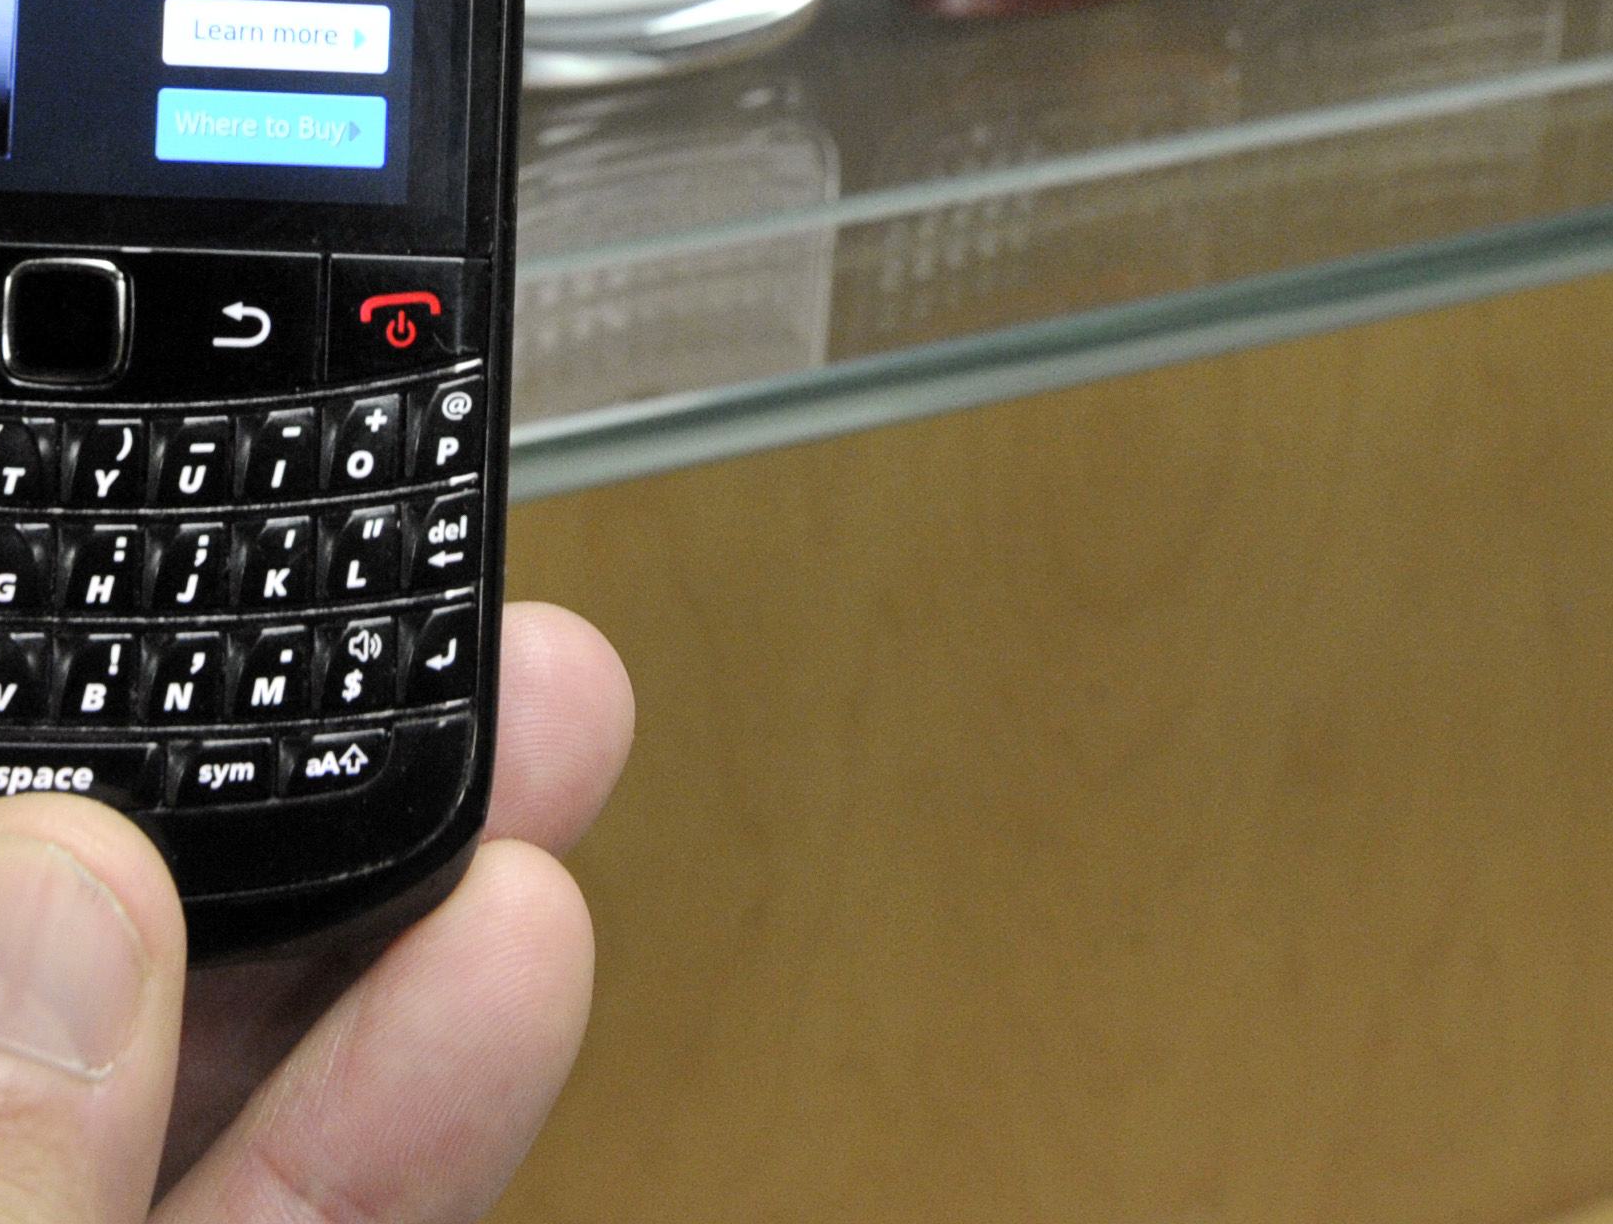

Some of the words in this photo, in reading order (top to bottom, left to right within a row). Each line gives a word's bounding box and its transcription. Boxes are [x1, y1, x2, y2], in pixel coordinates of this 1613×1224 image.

[193, 19, 264, 43] Learn
[273, 25, 339, 46] more
[174, 109, 259, 138] Where
[265, 115, 291, 138] to
[298, 115, 347, 147] Buy
[365, 408, 387, 432] +
[441, 391, 473, 421] @
[2, 468, 26, 495] T
[94, 469, 119, 497] Y
[179, 466, 206, 493] U
[437, 437, 459, 465] P
[428, 516, 467, 543] del
[86, 575, 115, 603] H
[176, 574, 199, 602] J
[264, 570, 290, 597] K
[346, 561, 366, 588] L
[81, 684, 107, 711] B
[164, 683, 194, 711] N
[251, 677, 286, 706] M
[199, 761, 255, 788] sym
